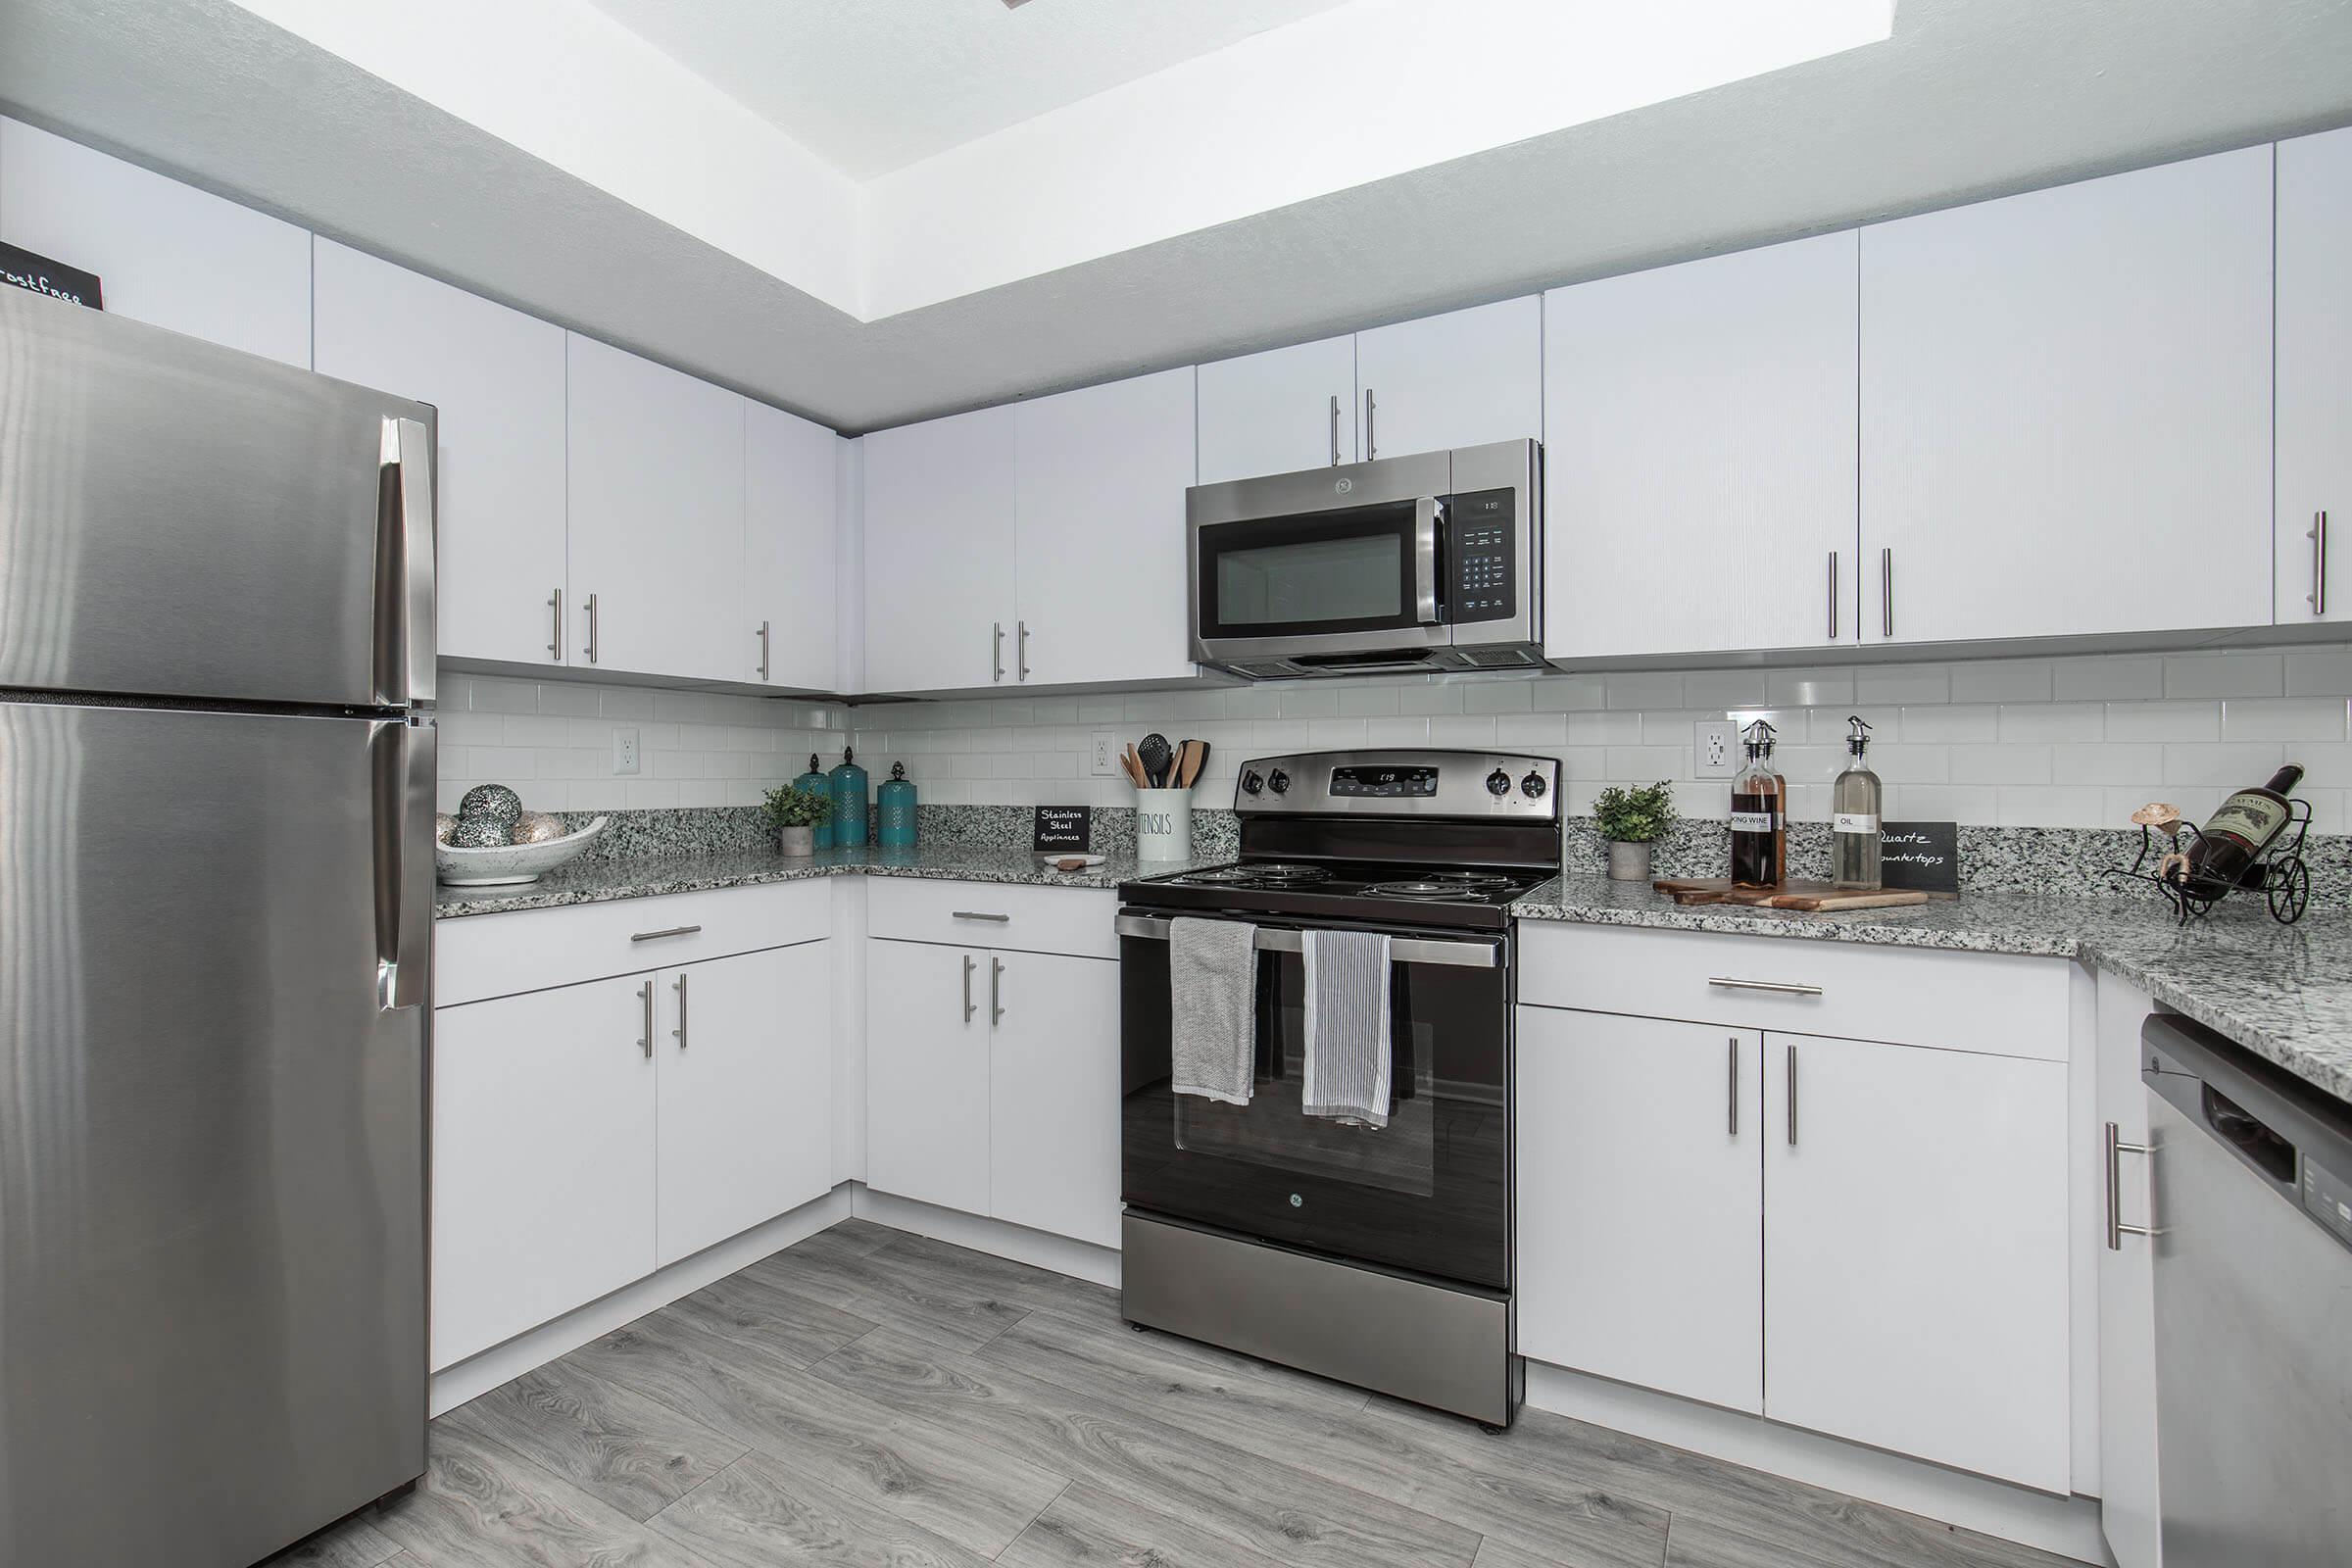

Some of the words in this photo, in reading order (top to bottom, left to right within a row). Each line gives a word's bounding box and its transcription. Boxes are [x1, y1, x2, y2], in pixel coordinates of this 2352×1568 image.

[1041, 809, 1082, 820] Stainless
[1051, 820, 1072, 830] Steel
[1040, 832, 1080, 843] Appliances
[1882, 853, 1944, 867] ountertops
